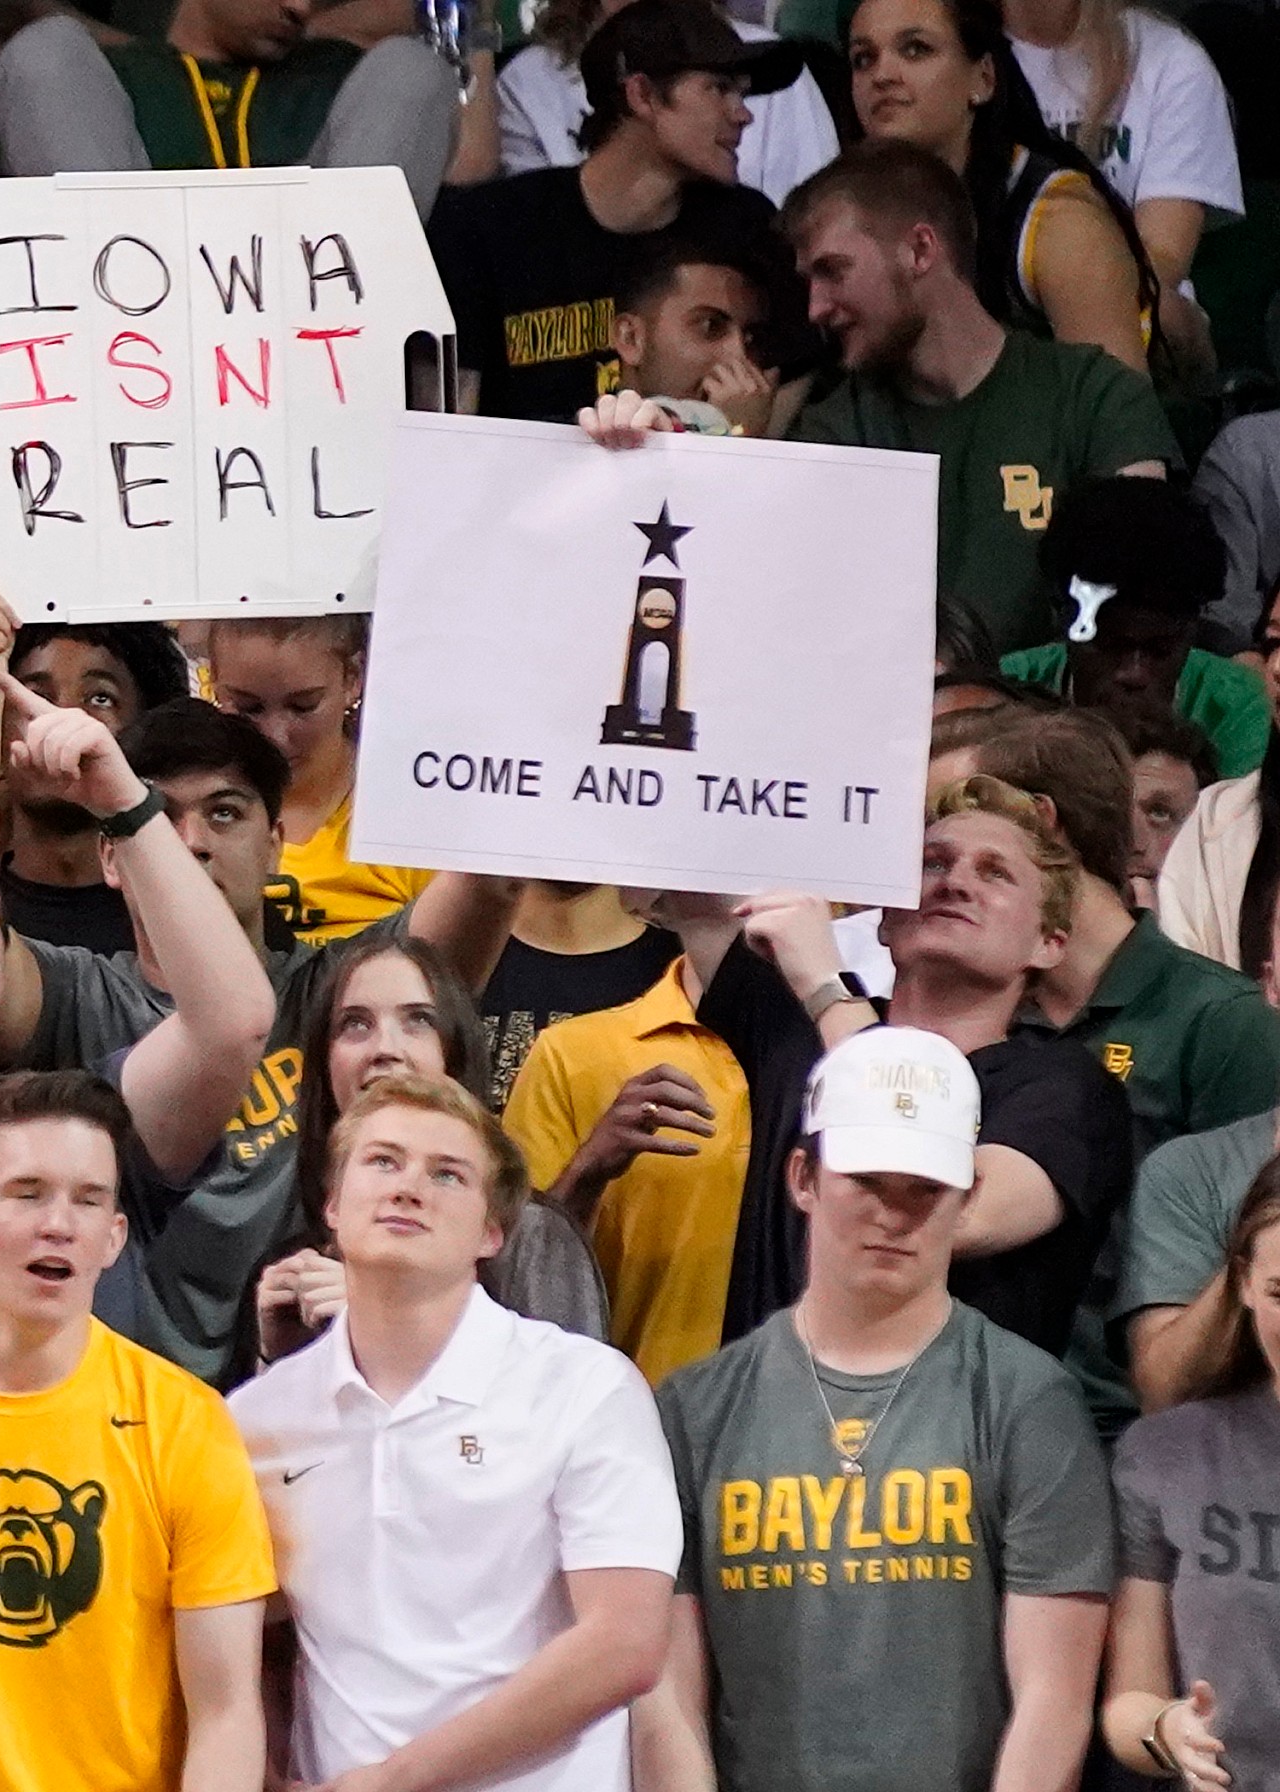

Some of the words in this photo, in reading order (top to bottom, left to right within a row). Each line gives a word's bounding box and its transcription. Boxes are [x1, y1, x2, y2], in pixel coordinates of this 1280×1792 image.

[504, 301, 596, 366] BAYLOR
[10, 441, 376, 536] REAL
[412, 751, 544, 798] COME
[572, 764, 664, 807] AND
[696, 773, 809, 819] TAKE
[843, 785, 880, 825] IT
[236, 1113, 299, 1160] ENN
[722, 1466, 975, 1557] BAYLOR
[721, 1562, 828, 1591] MEN'S
[843, 1555, 973, 1584] TENNIS
